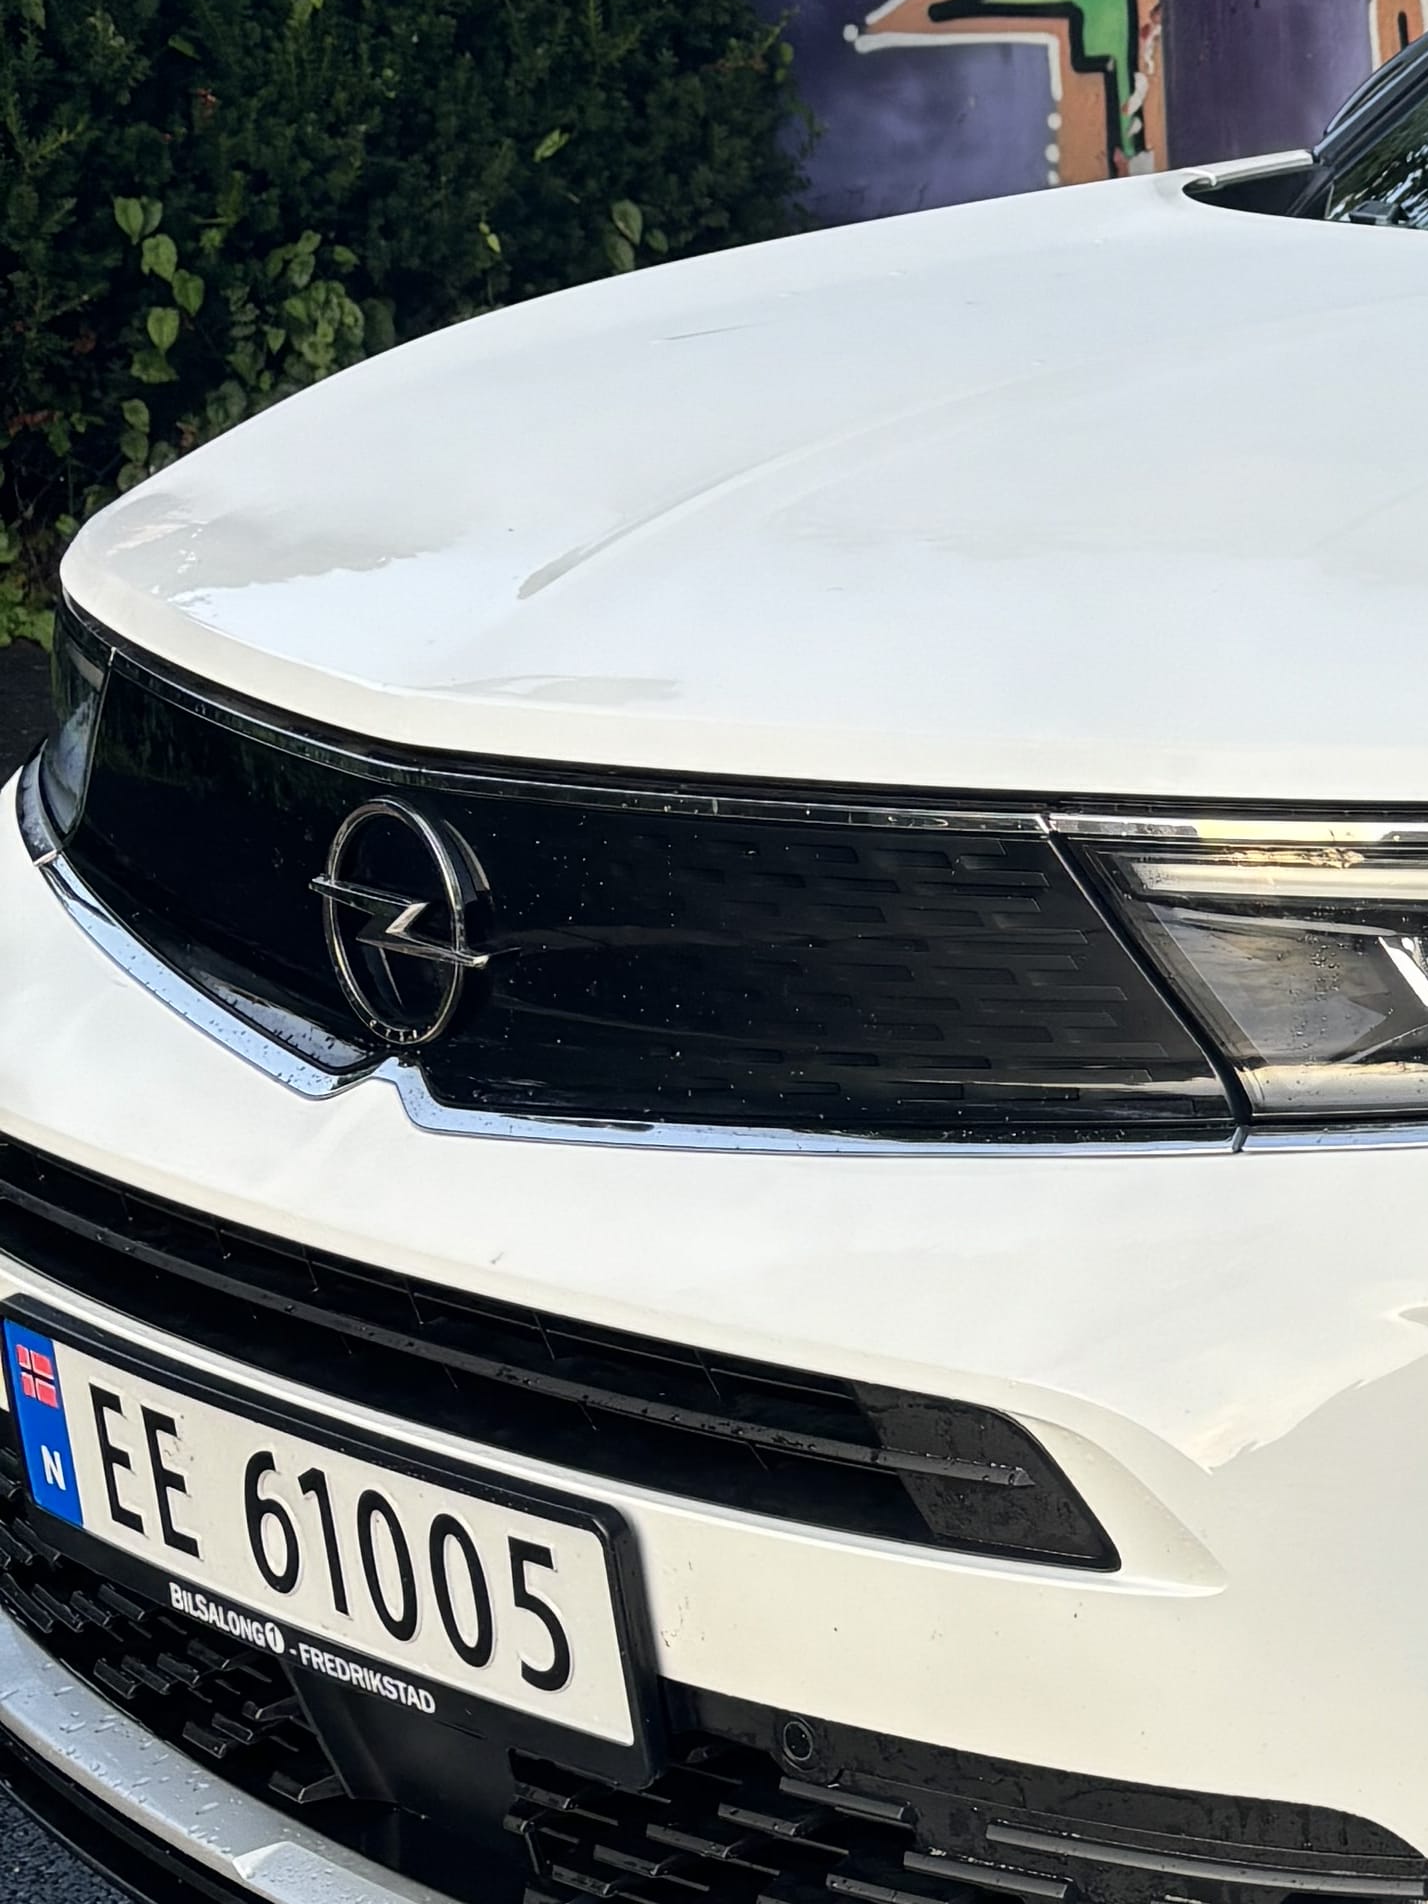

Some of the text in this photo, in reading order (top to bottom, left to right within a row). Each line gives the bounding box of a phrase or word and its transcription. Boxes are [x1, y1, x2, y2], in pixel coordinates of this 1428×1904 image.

[41, 1444, 66, 1491] N
[89, 1383, 572, 1693] EE 61005
[299, 1643, 436, 1714] FREDRIKSTAD
